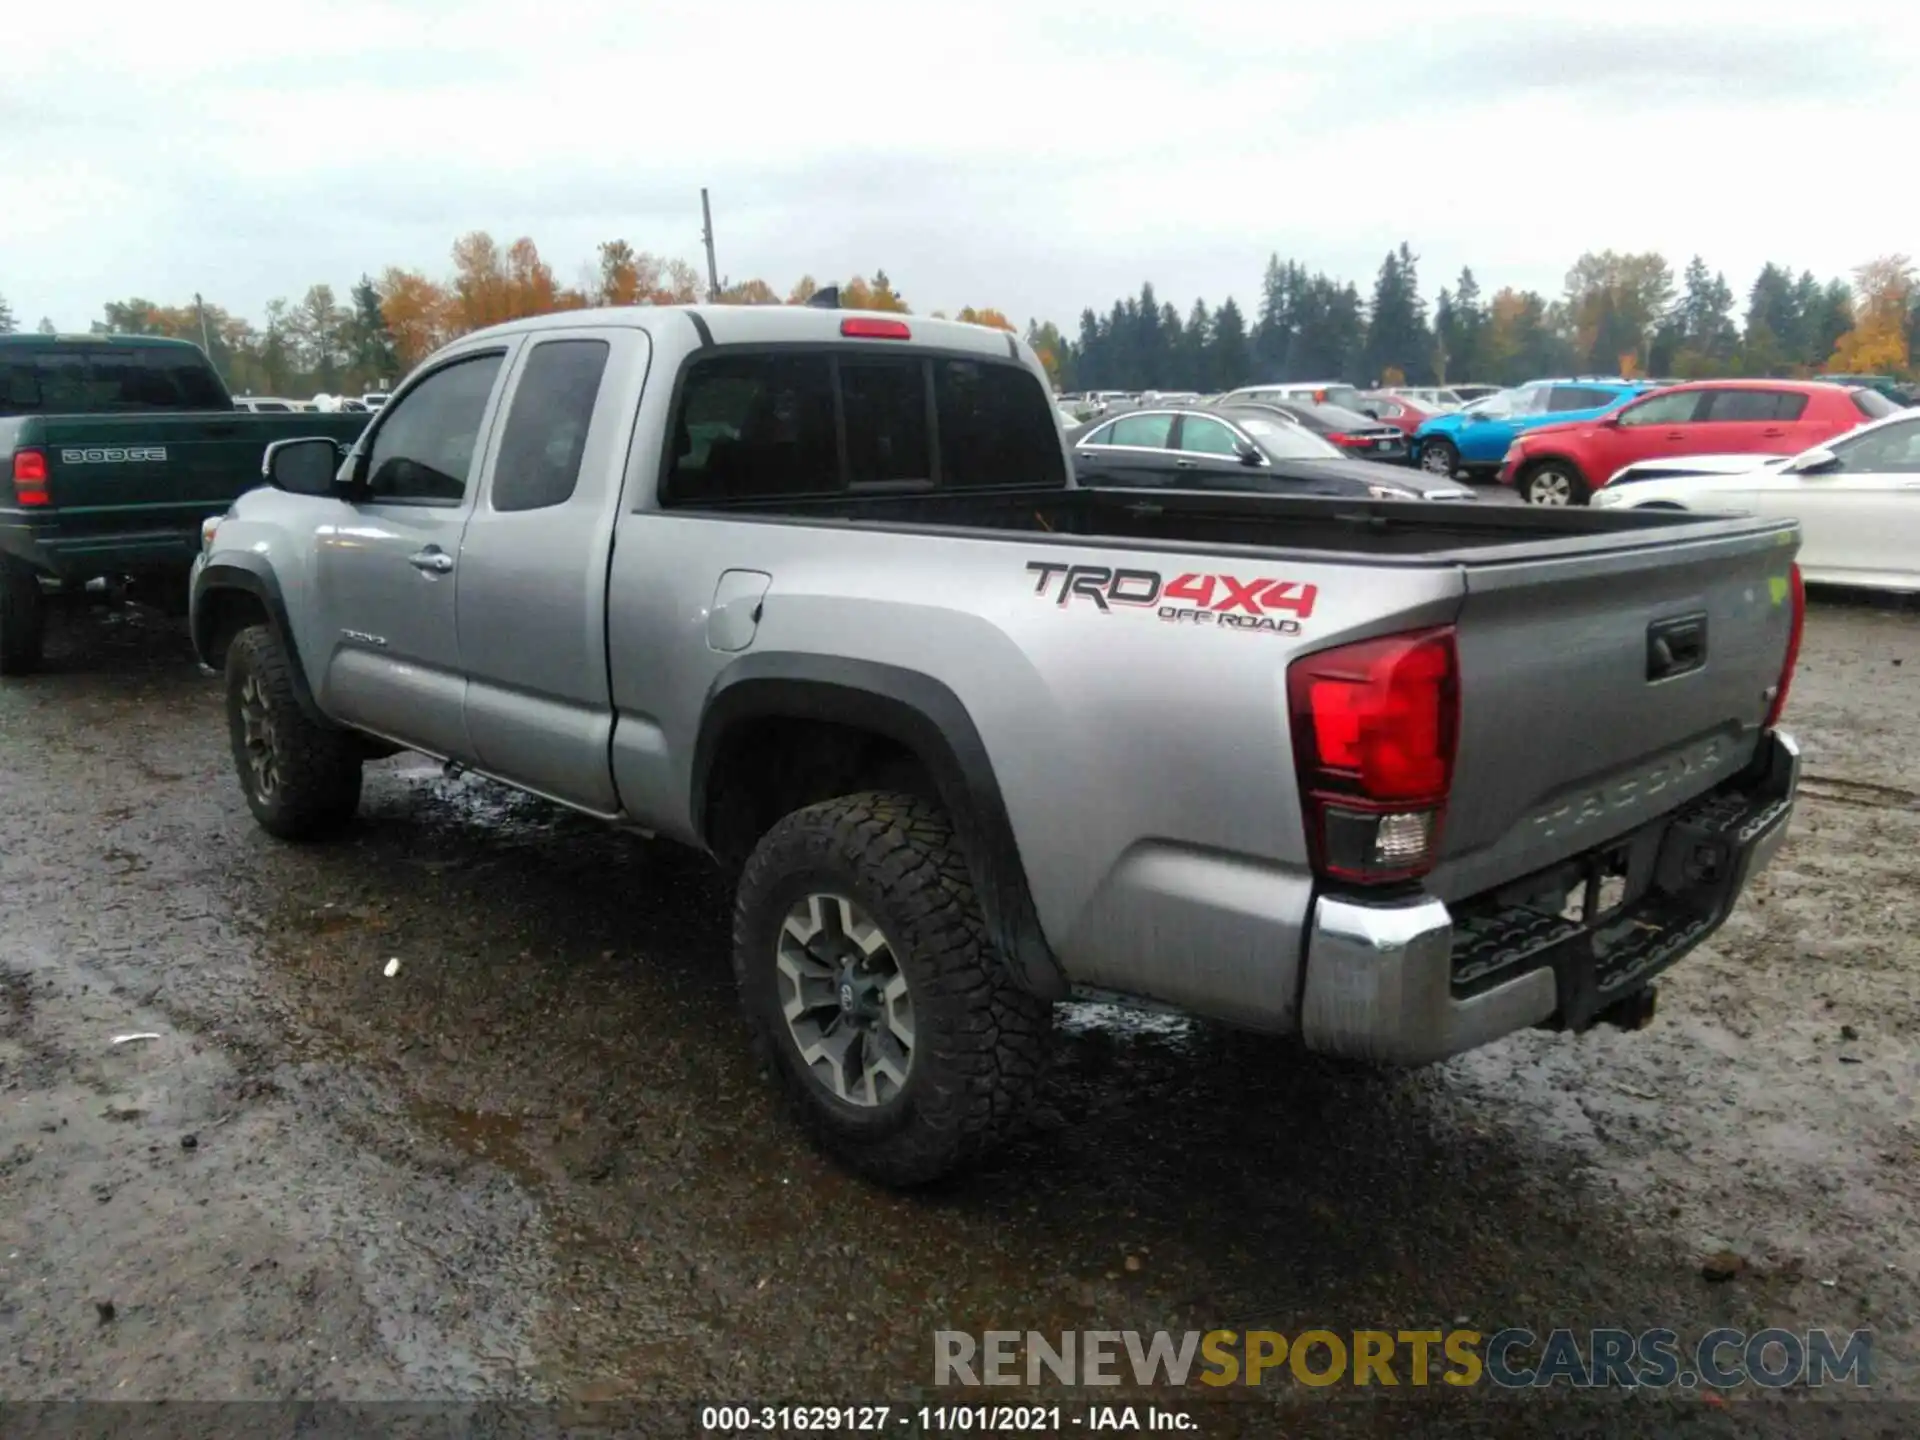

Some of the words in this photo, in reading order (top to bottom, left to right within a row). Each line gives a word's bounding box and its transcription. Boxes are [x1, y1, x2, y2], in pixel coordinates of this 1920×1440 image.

[61, 447, 167, 464] DODGE
[1025, 561, 1161, 615] TRD
[1164, 573, 1318, 618] 4X4
[1158, 606, 1212, 626] OFF
[1217, 612, 1301, 636] ROAD
